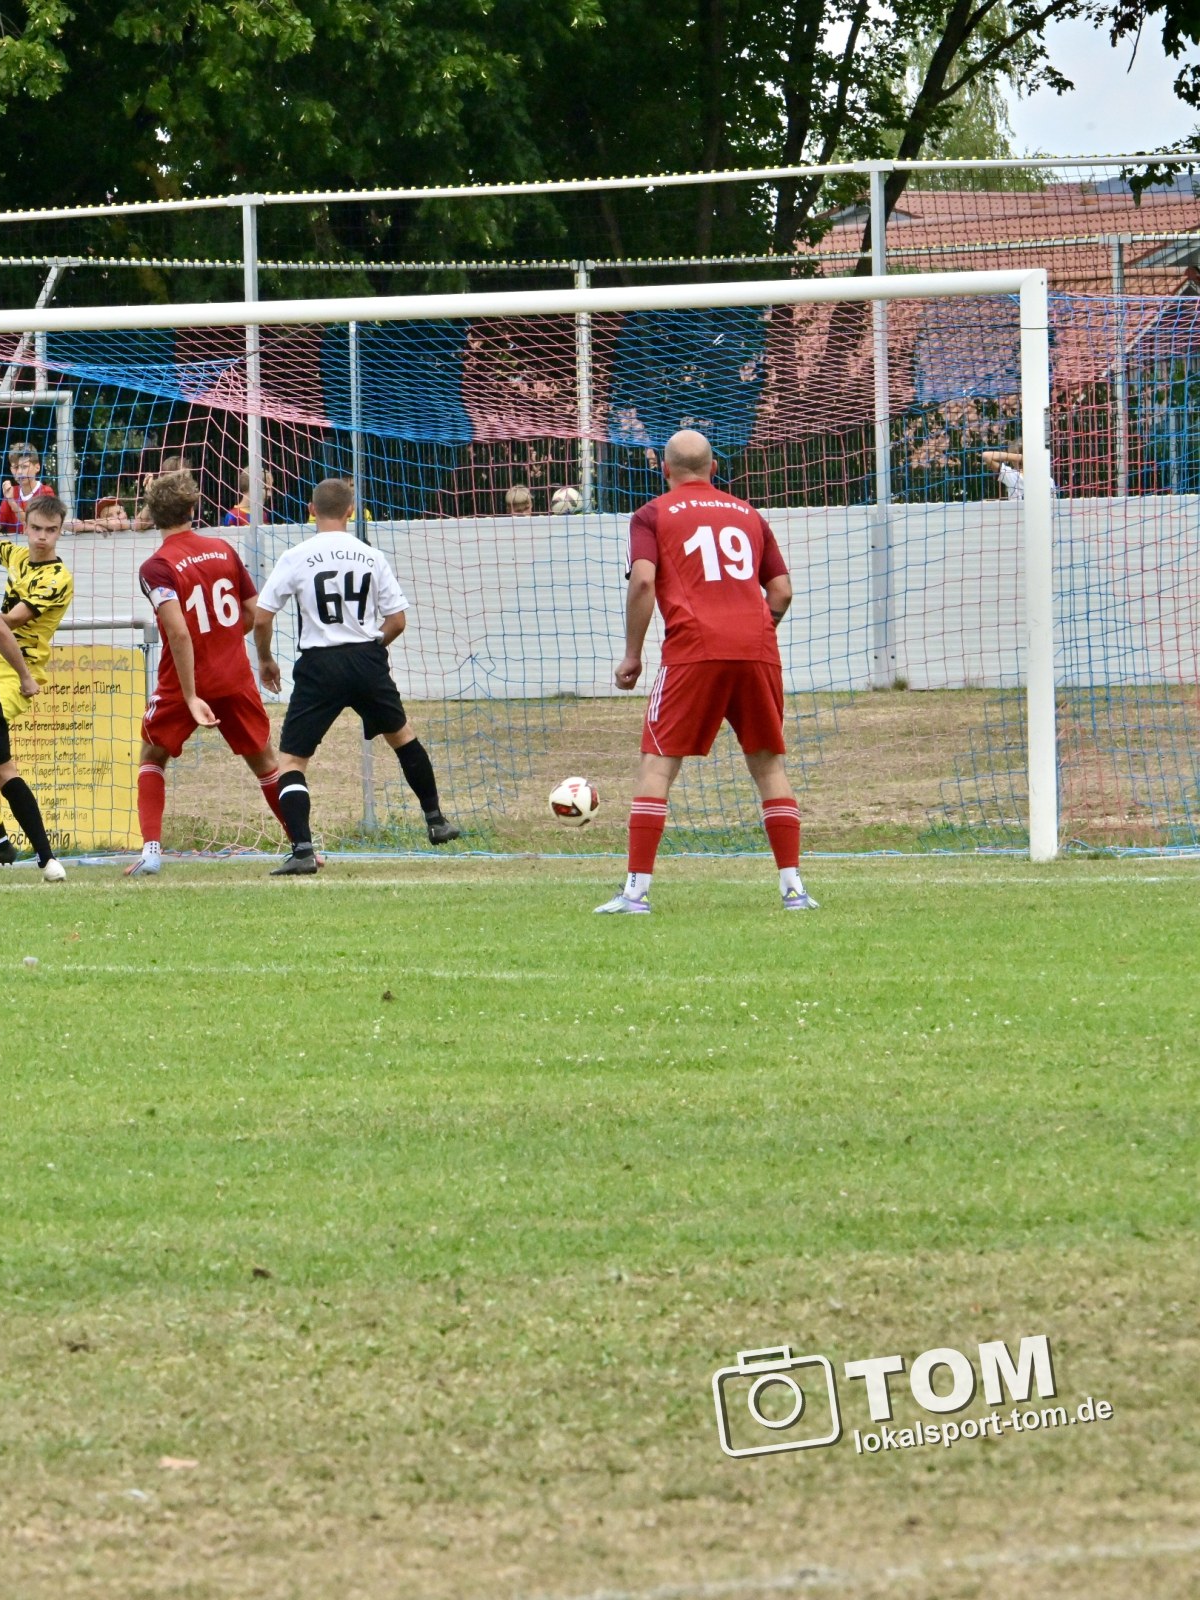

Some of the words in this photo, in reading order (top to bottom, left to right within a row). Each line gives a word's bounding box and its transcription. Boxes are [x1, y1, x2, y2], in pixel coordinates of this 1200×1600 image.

[668, 501, 688, 514] SV
[689, 500, 749, 515] Fuchstal
[175, 559, 188, 573] SV
[187, 551, 228, 565] Fuchstal
[330, 550, 375, 568] IGLING
[683, 526, 754, 582] 19
[186, 578, 240, 635] 16
[313, 570, 373, 626] 64
[43, 684, 71, 695] unter
[72, 681, 91, 695] den
[93, 680, 122, 694] Türen
[47, 828, 71, 850] önig
